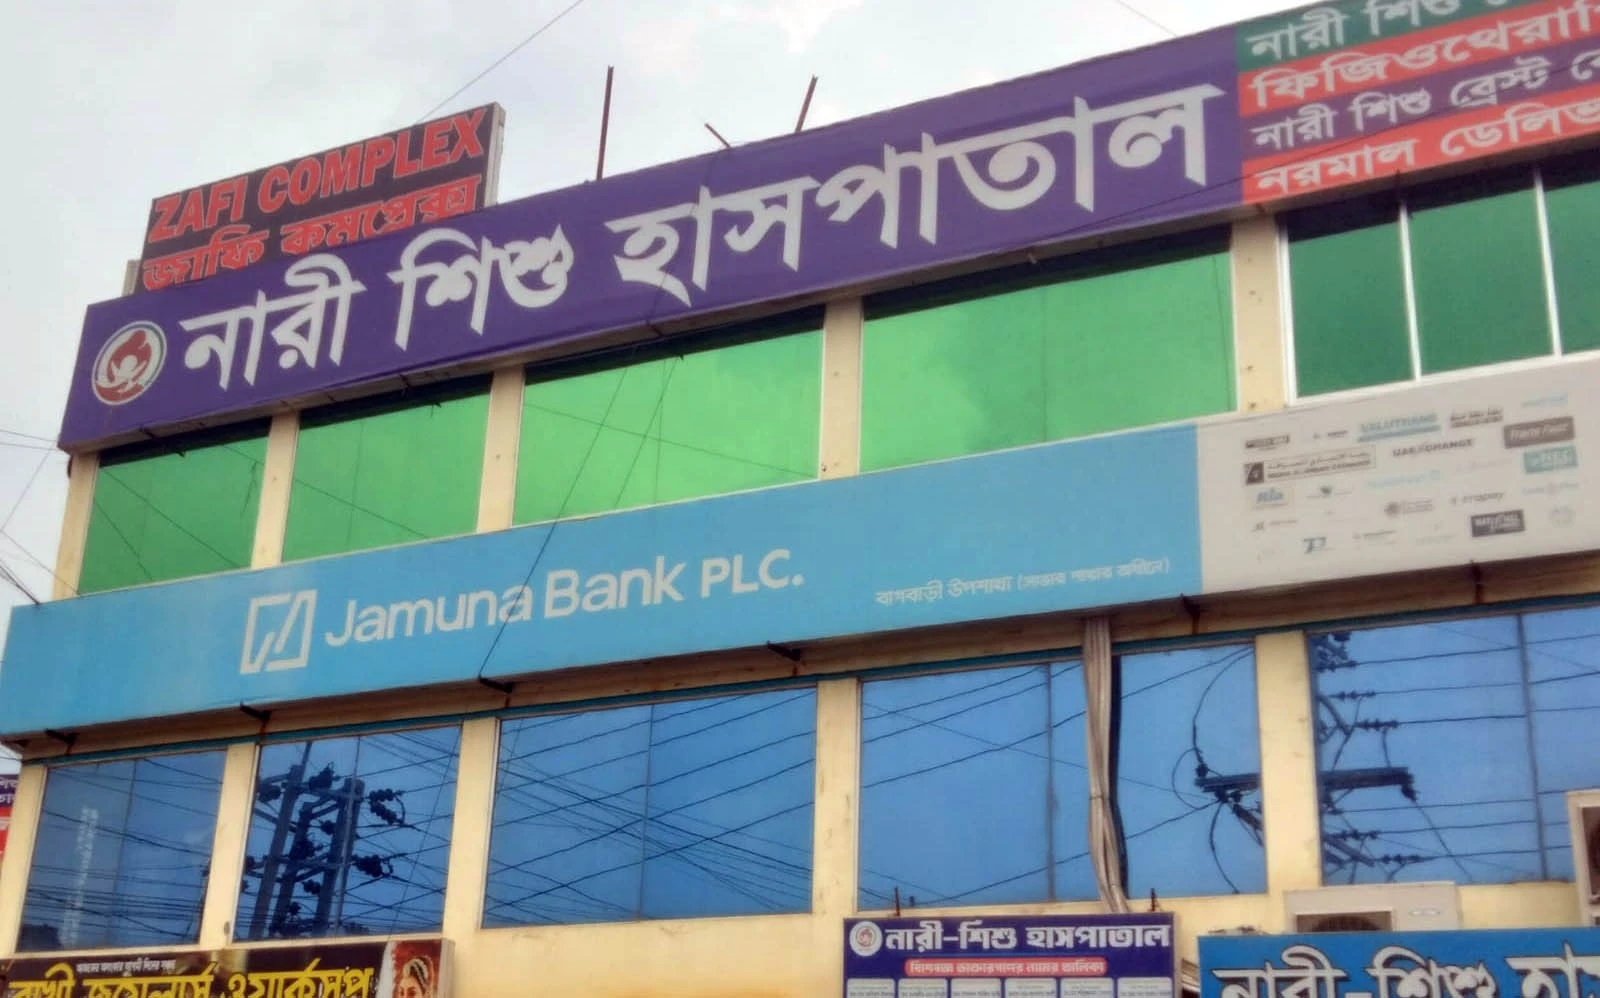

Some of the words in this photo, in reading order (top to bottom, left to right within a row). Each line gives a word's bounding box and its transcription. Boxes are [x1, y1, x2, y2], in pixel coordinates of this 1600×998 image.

[1245, 7, 1348, 60] নারী
[1250, 103, 1338, 149] নারী
[1347, 88, 1431, 131] শিশু
[148, 175, 249, 243] ZAFI
[257, 107, 487, 214] COMPLEX
[1256, 137, 1419, 194] নরমাল
[142, 224, 270, 290] জাফি
[180, 253, 366, 391] নারী
[387, 227, 574, 352] শিশু
[604, 83, 1226, 309] হাসপাতাল
[323, 583, 533, 647] Jamuna
[543, 555, 687, 620] Bank
[700, 548, 806, 600] PLC.
[885, 920, 1017, 952] নারী-শিশু
[1026, 924, 1171, 949] হাসপাতাল
